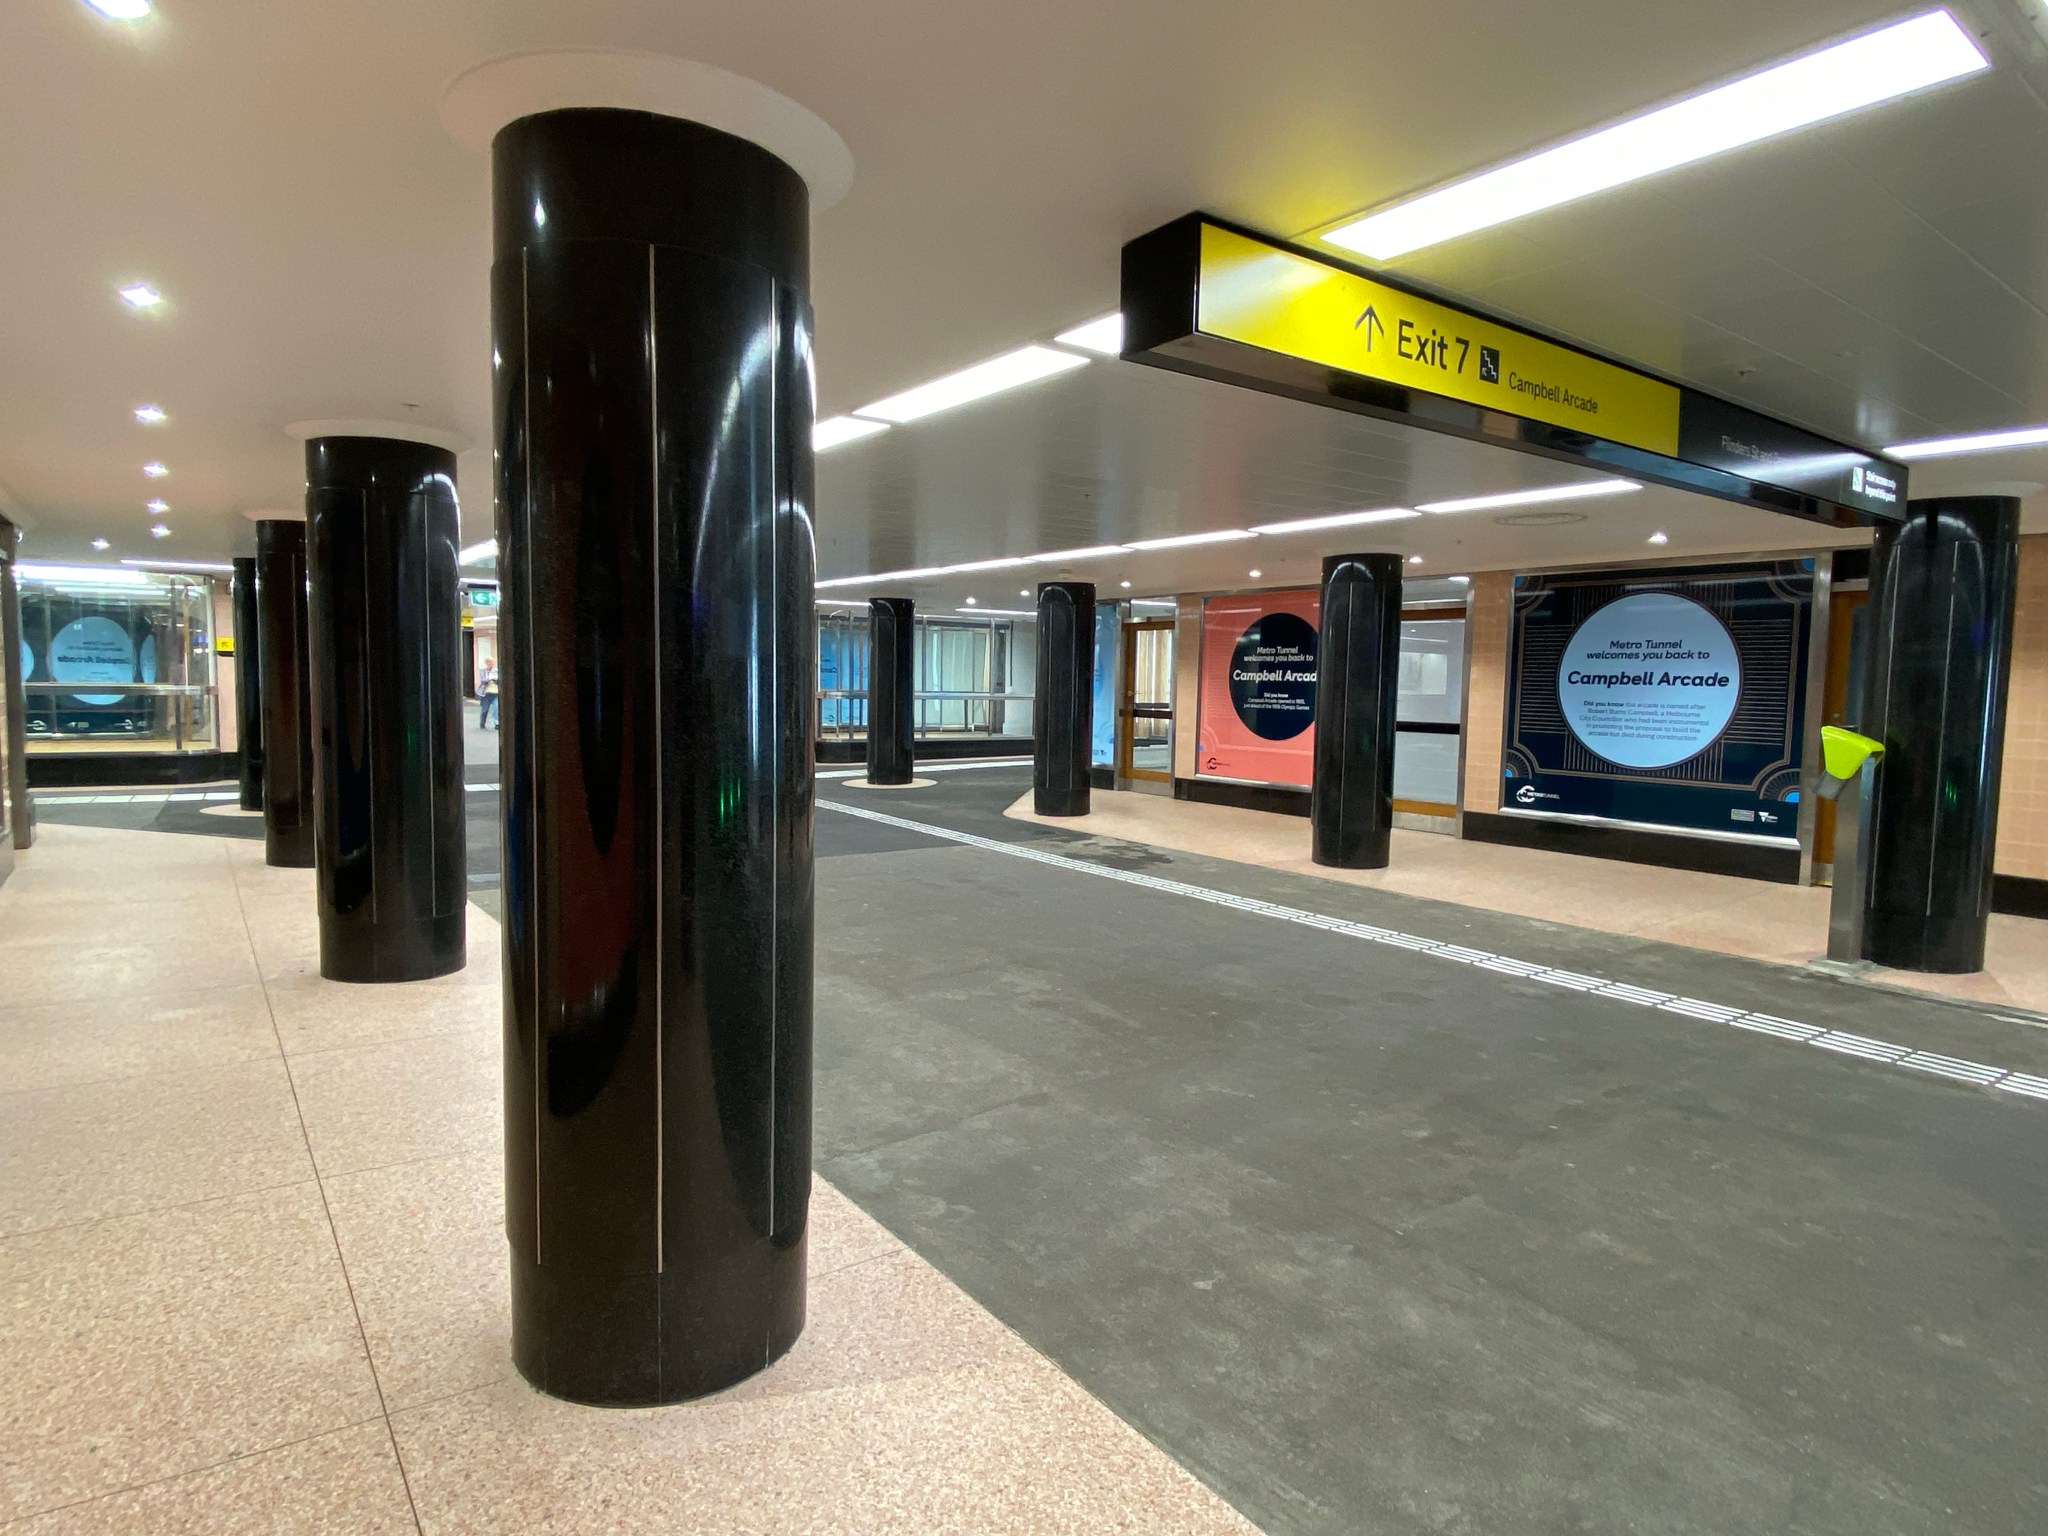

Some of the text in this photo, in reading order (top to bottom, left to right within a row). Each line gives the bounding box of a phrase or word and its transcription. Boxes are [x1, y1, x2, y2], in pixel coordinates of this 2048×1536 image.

[1397, 318, 1470, 374] Exit 7
[1508, 371, 1599, 414] Campbell Arcade
[1257, 646, 1299, 654] Metro Tunnel
[1609, 639, 1682, 650] Metro Tunnel
[1244, 654, 1314, 663] welcomes you back to
[1586, 650, 1710, 662] welcomes you back to
[1233, 669, 1318, 684] Campbell Arcad
[1567, 670, 1730, 688] Campbell Arcade
[1665, 710, 1701, 718] Melbourne
